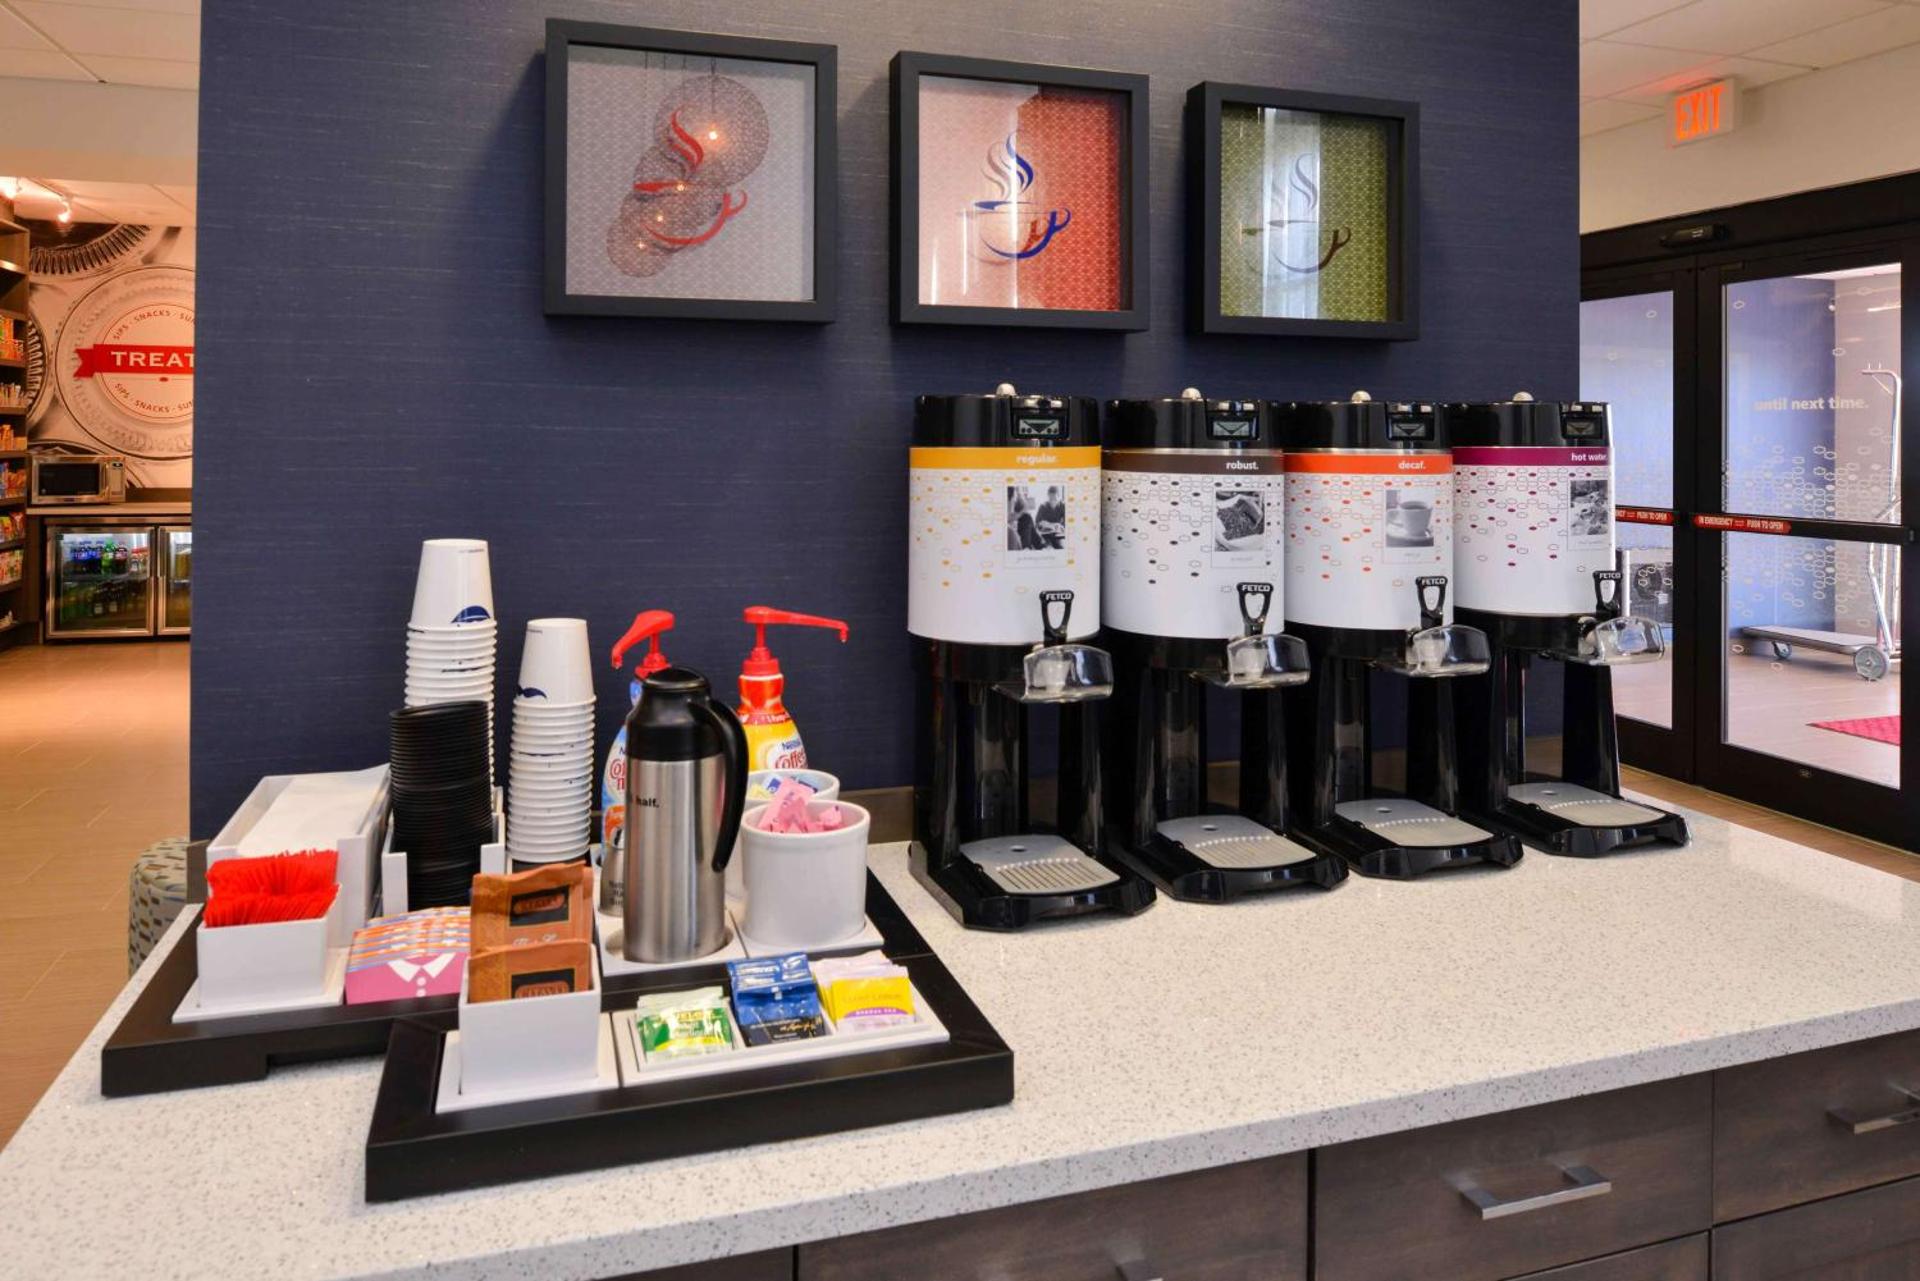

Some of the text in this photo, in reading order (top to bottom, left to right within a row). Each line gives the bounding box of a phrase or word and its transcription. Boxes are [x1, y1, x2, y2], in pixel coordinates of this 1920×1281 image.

[1676, 84, 1725, 142] EXIT
[134, 310, 170, 322] SNACKS
[135, 400, 170, 413] SNACKS
[1754, 397, 1869, 410] until next time.
[1016, 454, 1059, 465] regular.
[1571, 452, 1587, 462] hot
[1226, 460, 1259, 470] robust.
[1398, 460, 1426, 470] decaf.
[1599, 571, 1621, 579] FETCO
[1421, 577, 1446, 585] FETCO
[1241, 584, 1271, 593] FETCO
[1045, 593, 1072, 601] FETCO
